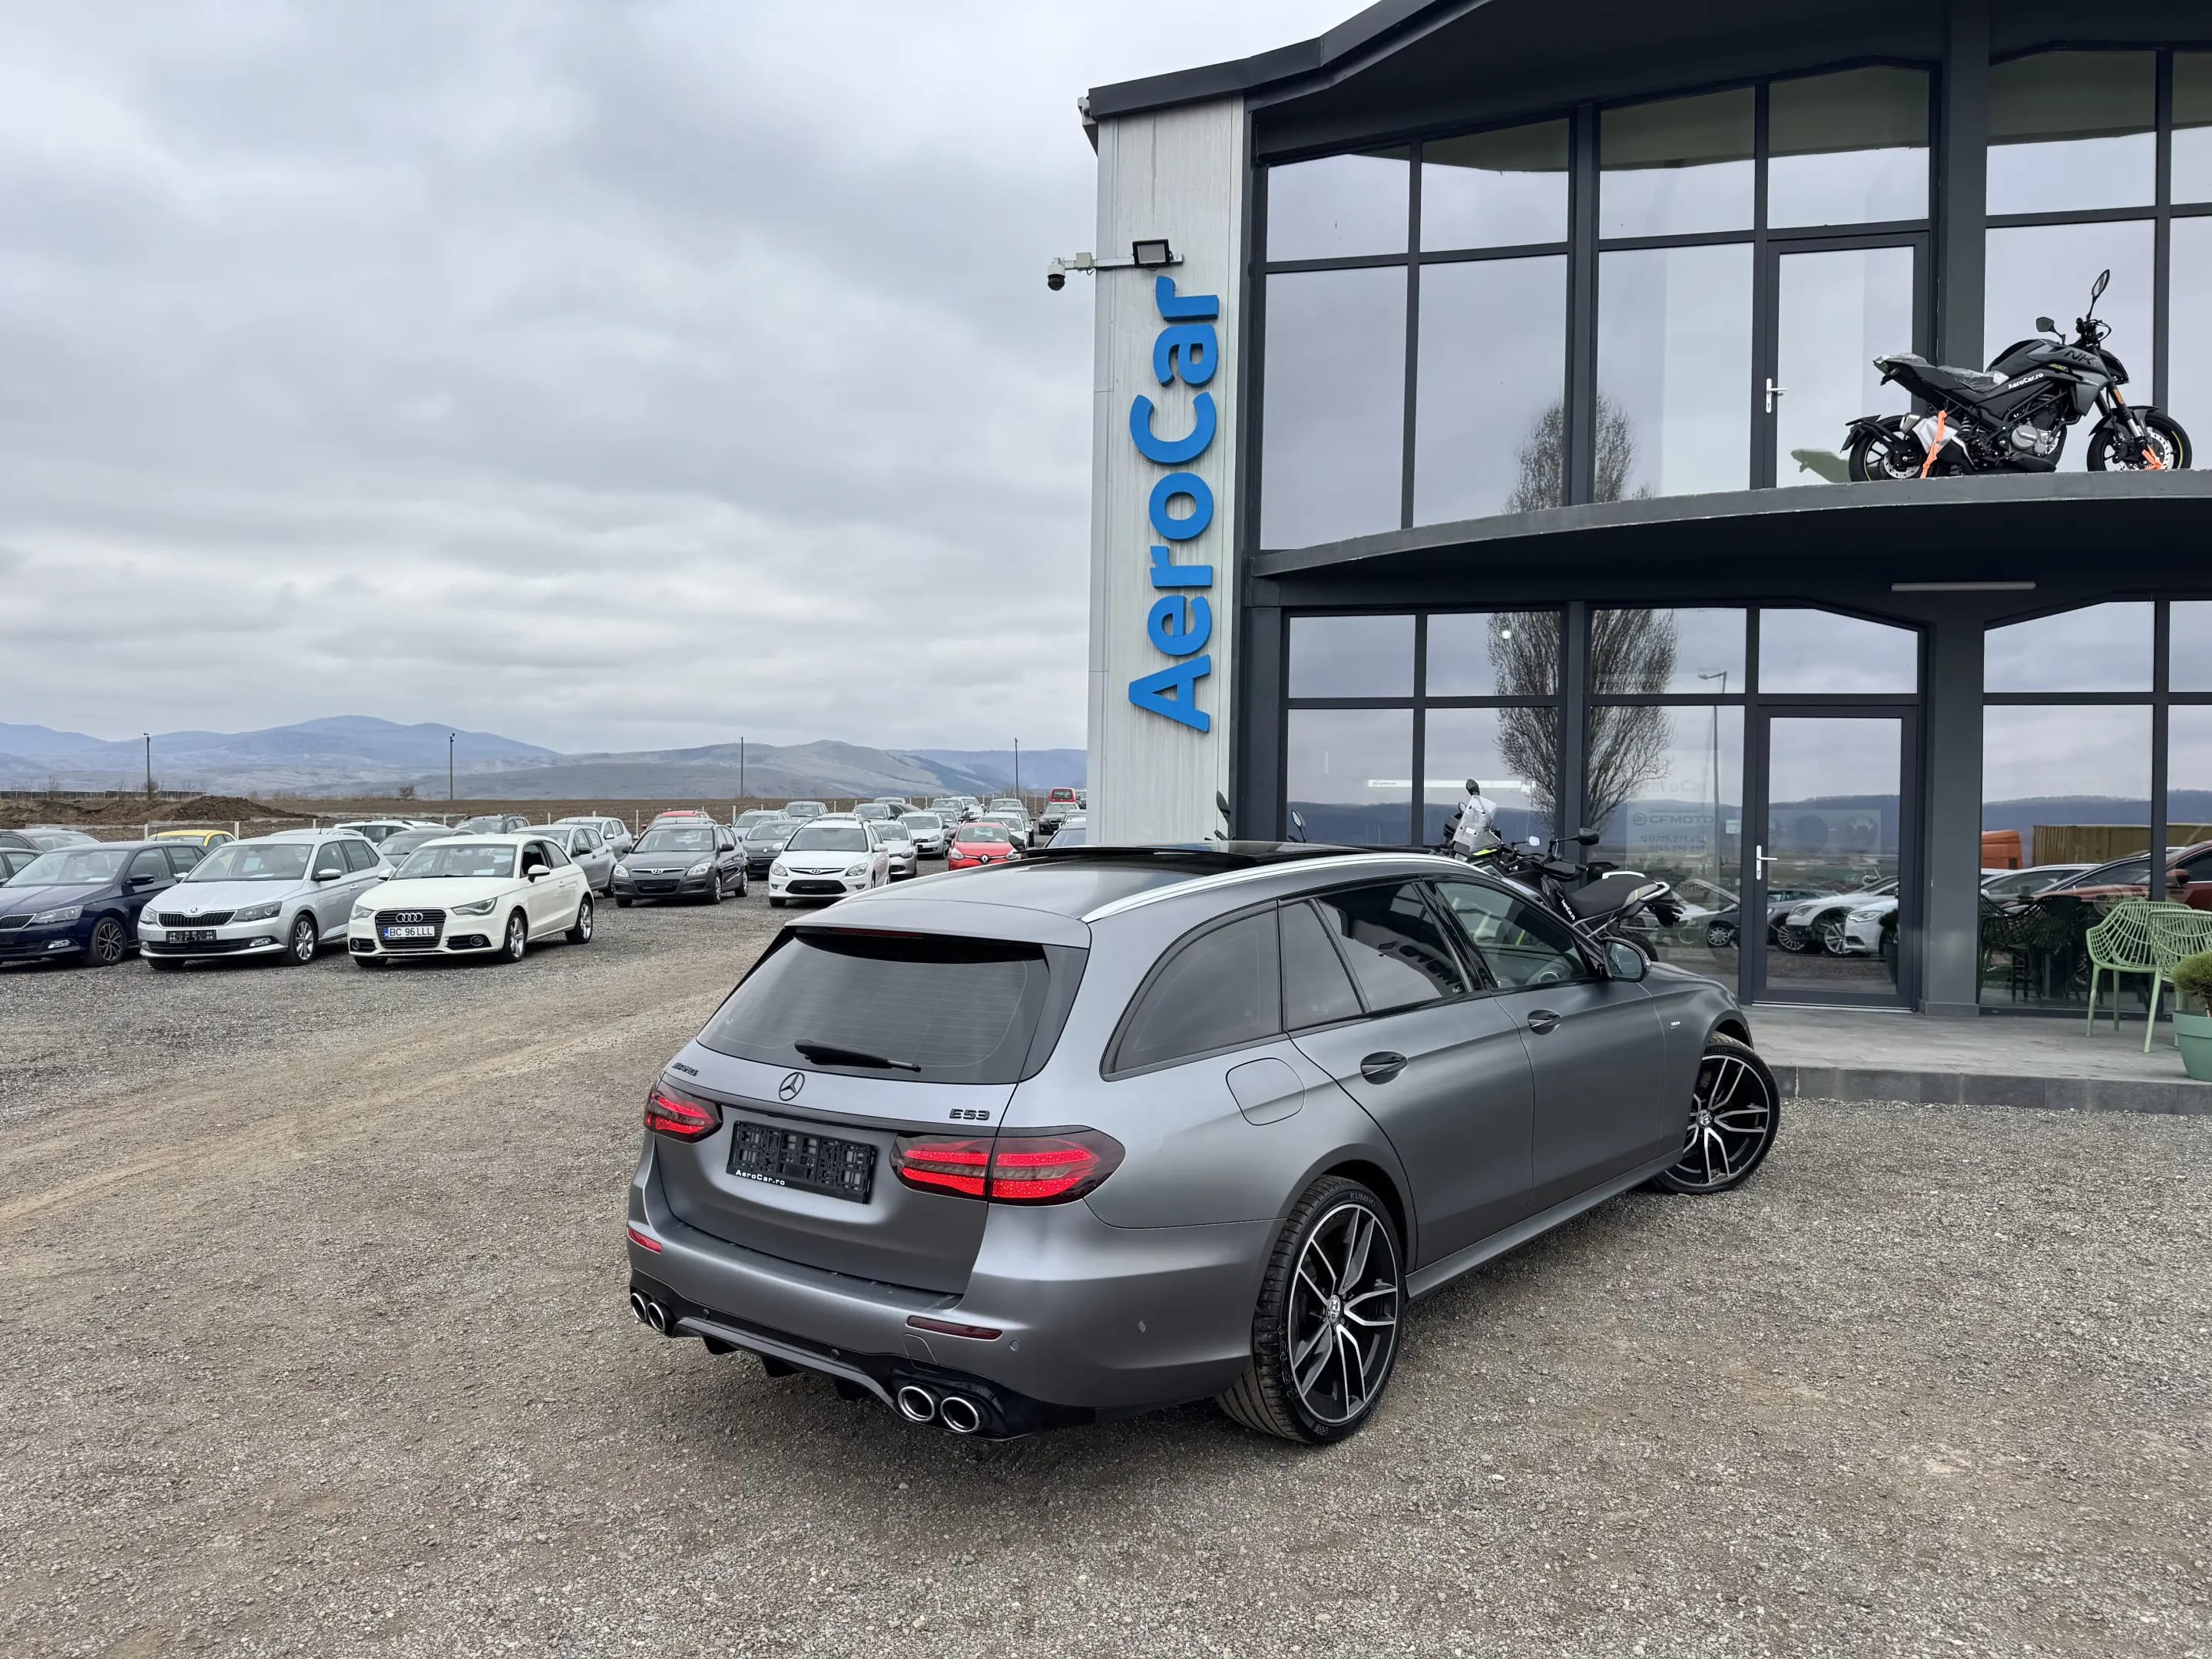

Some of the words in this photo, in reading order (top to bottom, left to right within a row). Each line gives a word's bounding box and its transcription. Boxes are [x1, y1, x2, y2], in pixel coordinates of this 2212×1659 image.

[2008, 373, 2044, 390] AeroCar.ro
[1128, 275, 1219, 733] AeroCar
[1649, 815, 1714, 824] CFMOTO
[389, 928, 402, 936] BC
[405, 928, 416, 936] 96
[417, 927, 432, 935] LLL
[949, 1108, 990, 1121] E53
[735, 1169, 786, 1186] AeroCar.ro
[1349, 1191, 1376, 1207] KUMHO
